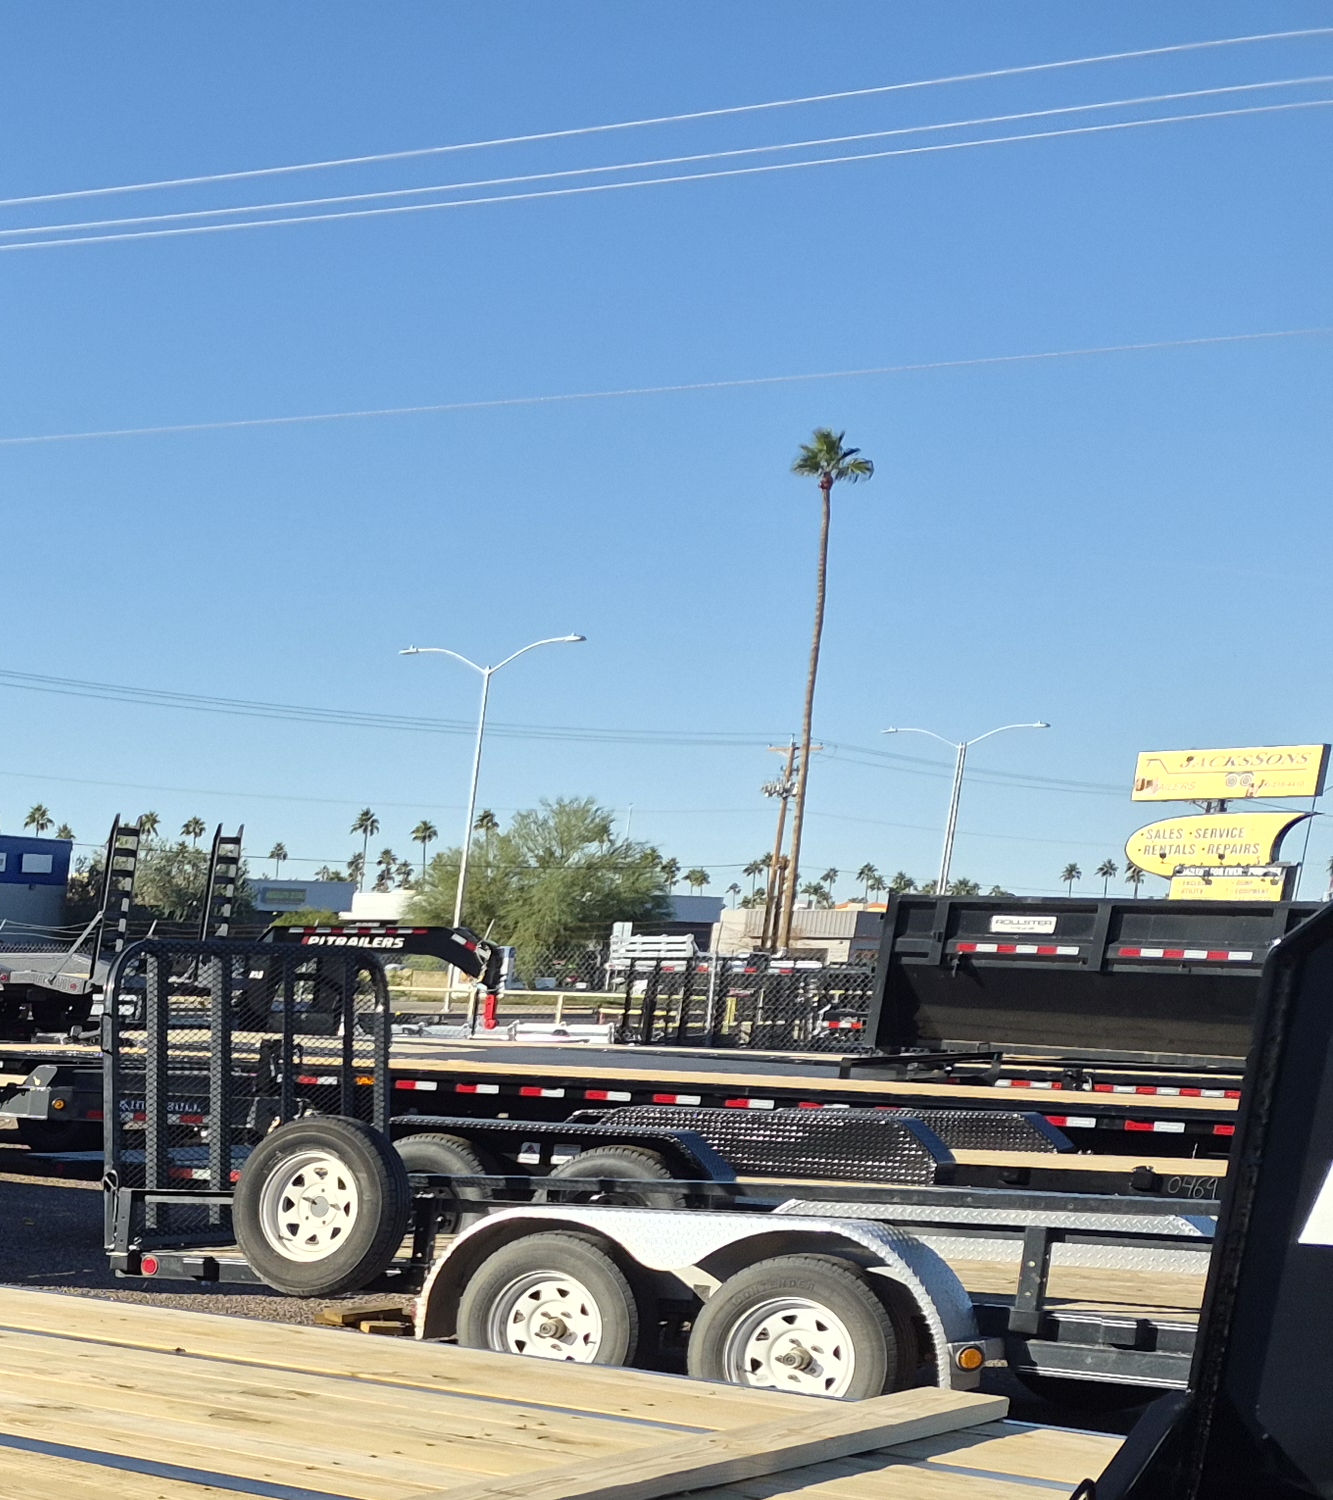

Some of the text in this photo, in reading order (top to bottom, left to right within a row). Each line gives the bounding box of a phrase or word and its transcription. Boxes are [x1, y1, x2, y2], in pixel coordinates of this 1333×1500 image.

[1146, 827, 1246, 840] SALES SERVICE
[1143, 843, 1260, 856] RENTALS REPAIRS
[1167, 1176, 1219, 1200] 0469
